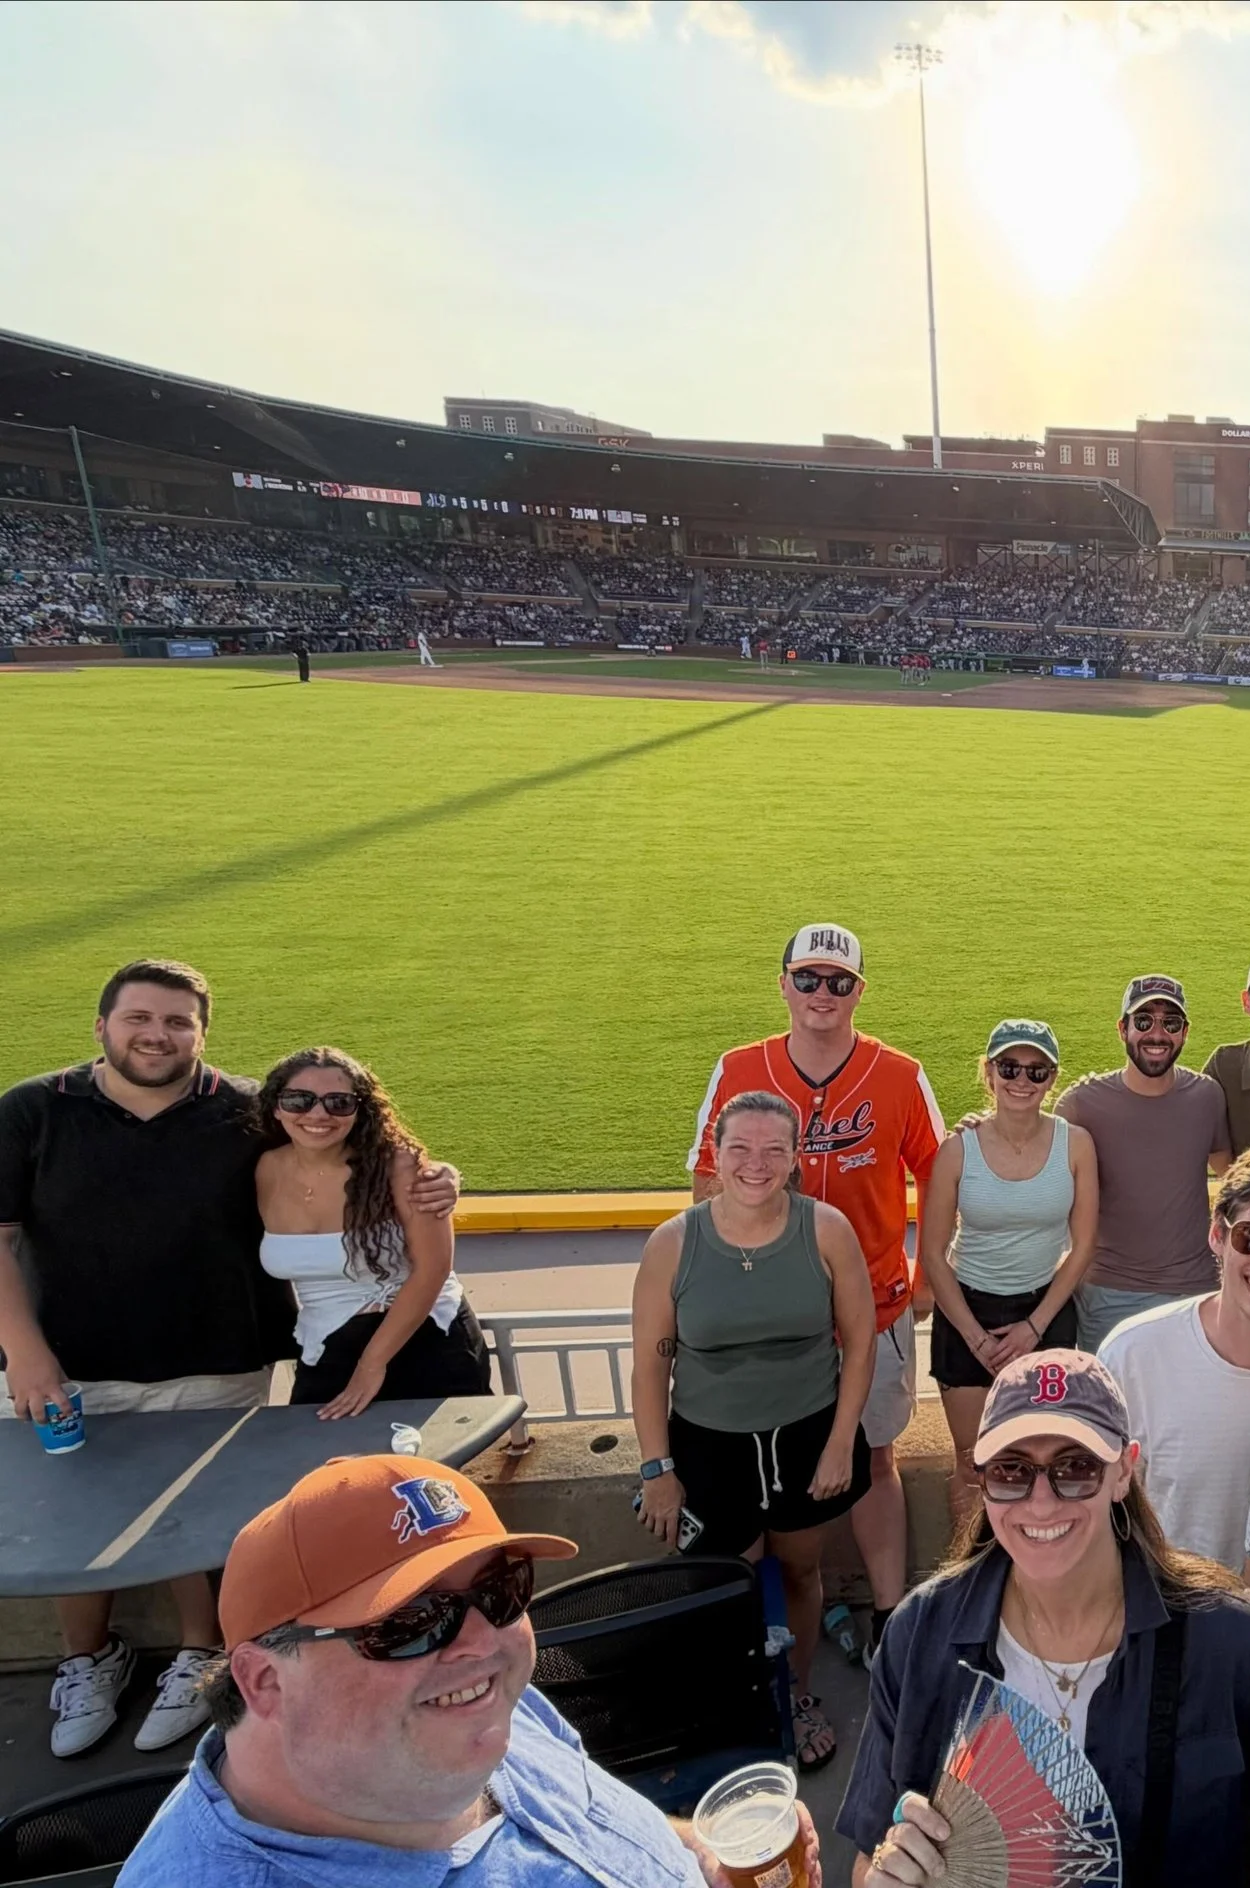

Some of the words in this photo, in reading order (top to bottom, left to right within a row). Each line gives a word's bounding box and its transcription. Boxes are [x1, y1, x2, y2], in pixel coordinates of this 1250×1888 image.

[1221, 429, 1250, 438] DOLLAR
[1011, 460, 1044, 471] XPERI
[808, 929, 849, 957] BULLS
[804, 1100, 876, 1138] bel
[804, 1142, 834, 1152] ANCE
[1031, 1362, 1069, 1404] B
